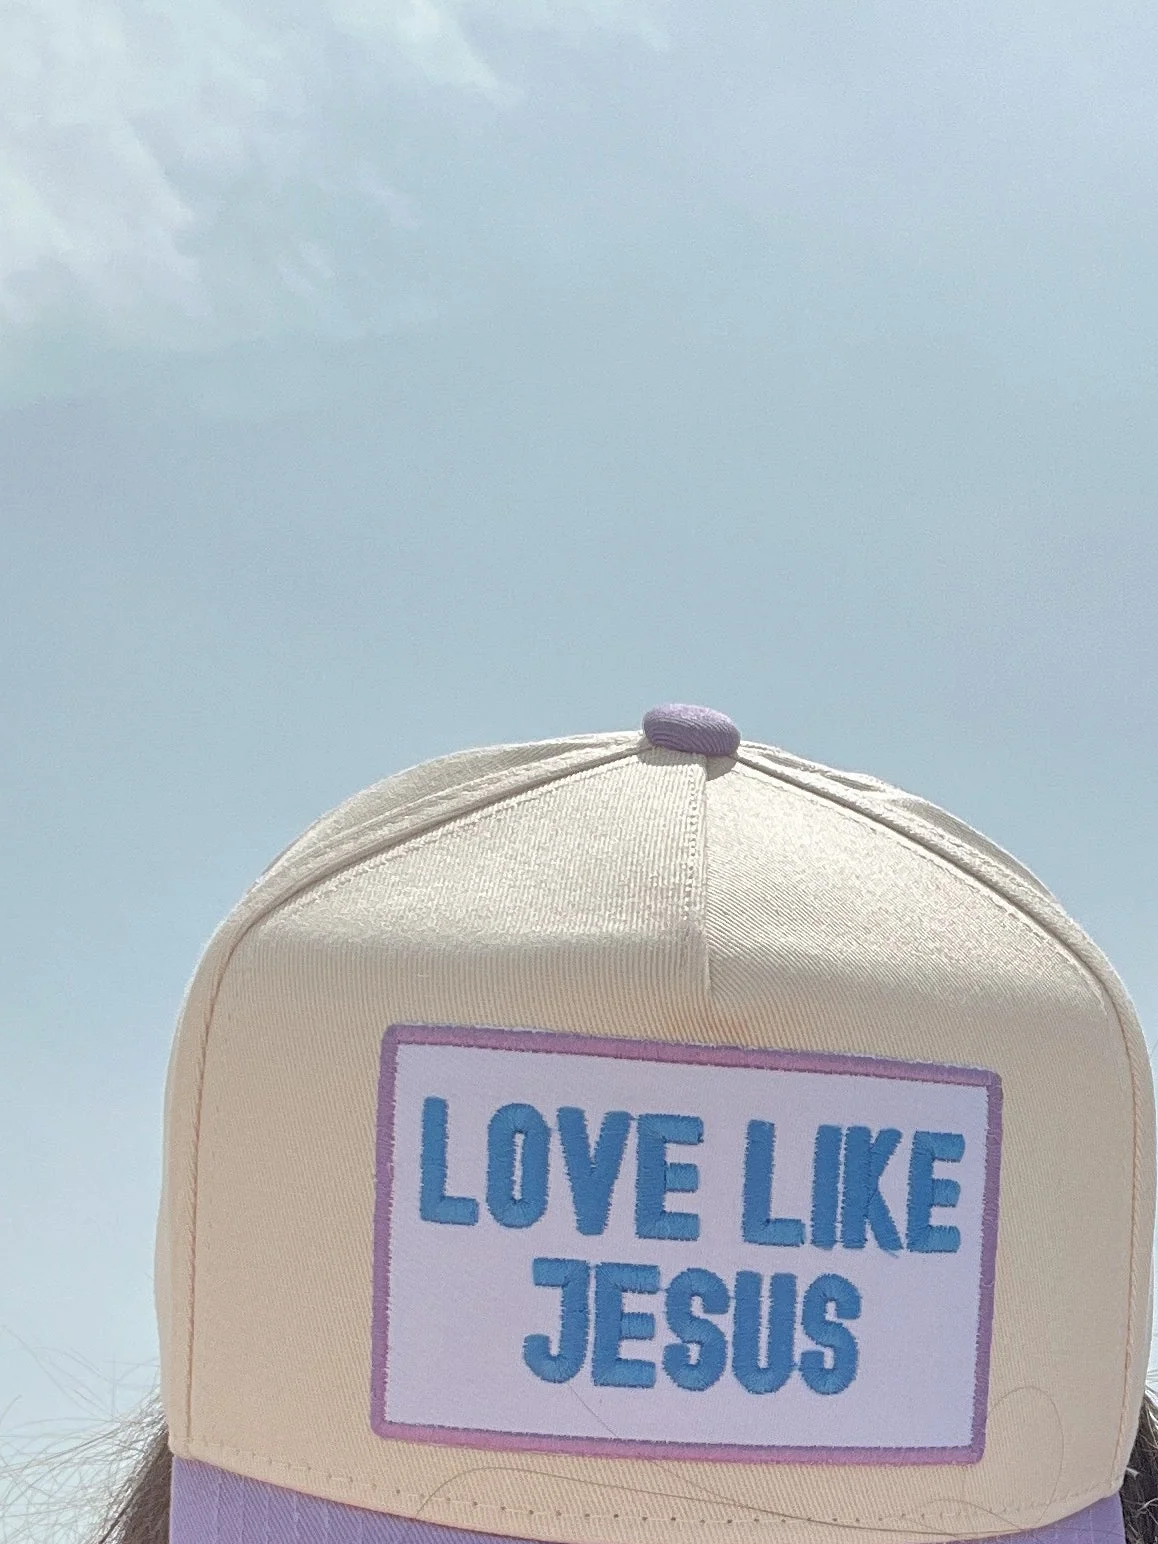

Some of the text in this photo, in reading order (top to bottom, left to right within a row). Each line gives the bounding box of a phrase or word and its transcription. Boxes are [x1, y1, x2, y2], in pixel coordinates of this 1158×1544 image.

[419, 1096, 966, 1256] LOVE LIKE
[522, 1257, 862, 1395] JESUS
